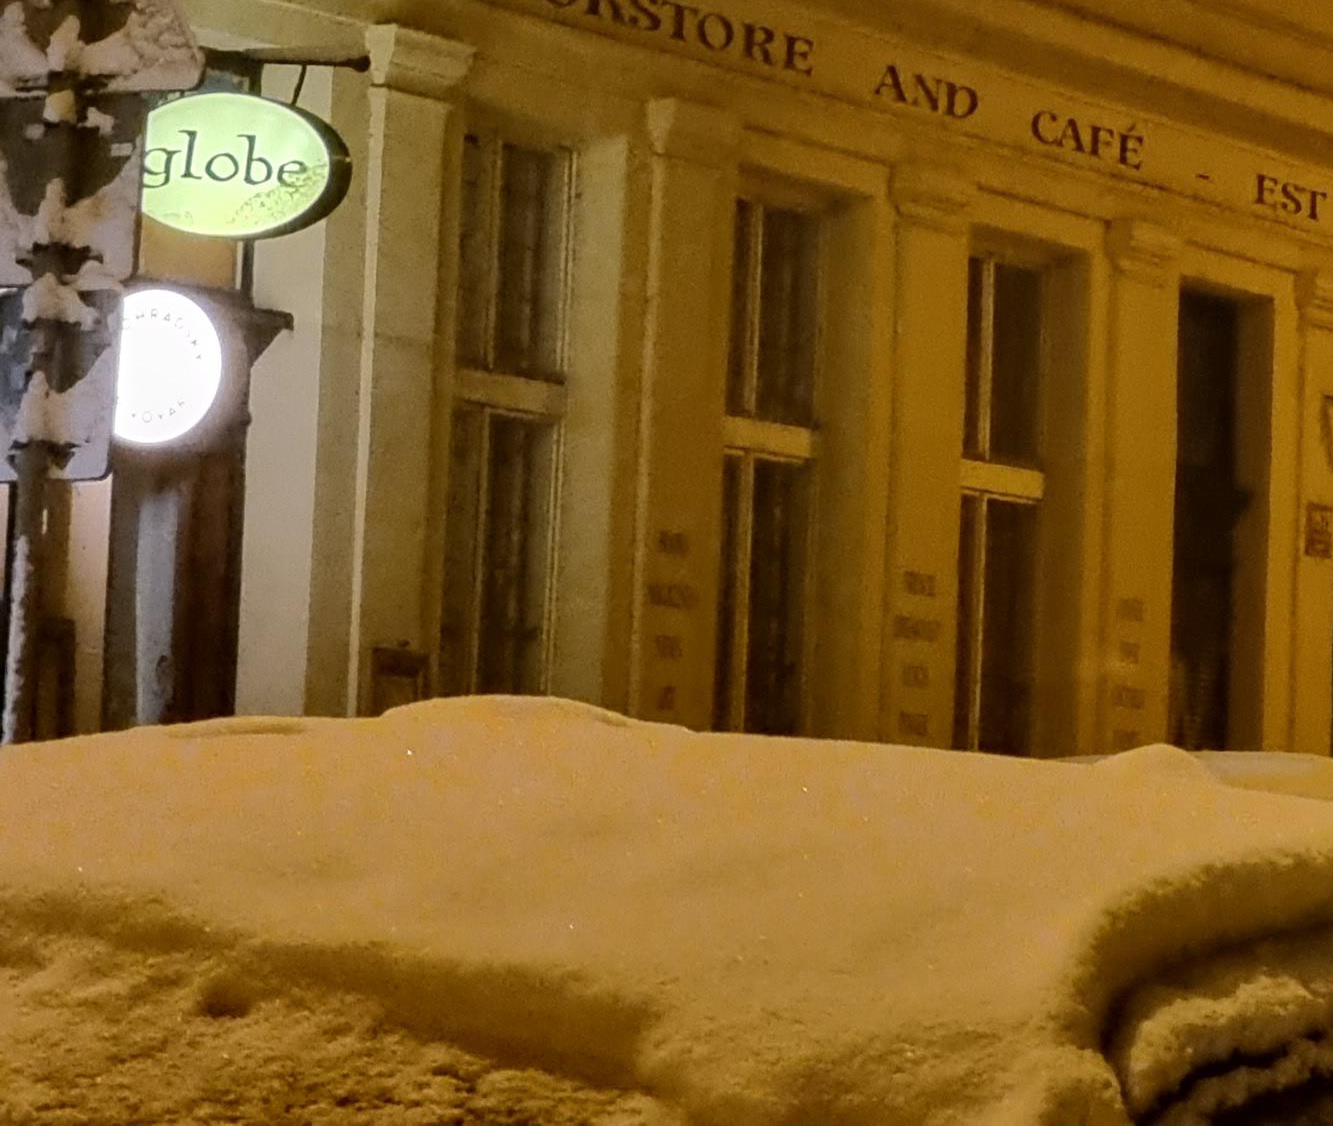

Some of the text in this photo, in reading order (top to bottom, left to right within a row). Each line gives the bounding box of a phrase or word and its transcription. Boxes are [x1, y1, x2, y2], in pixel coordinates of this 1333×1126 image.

[143, 130, 308, 188] globe
[874, 65, 978, 119] AND
[1031, 110, 1144, 171] CAFÉ
[1254, 173, 1327, 221] EST
